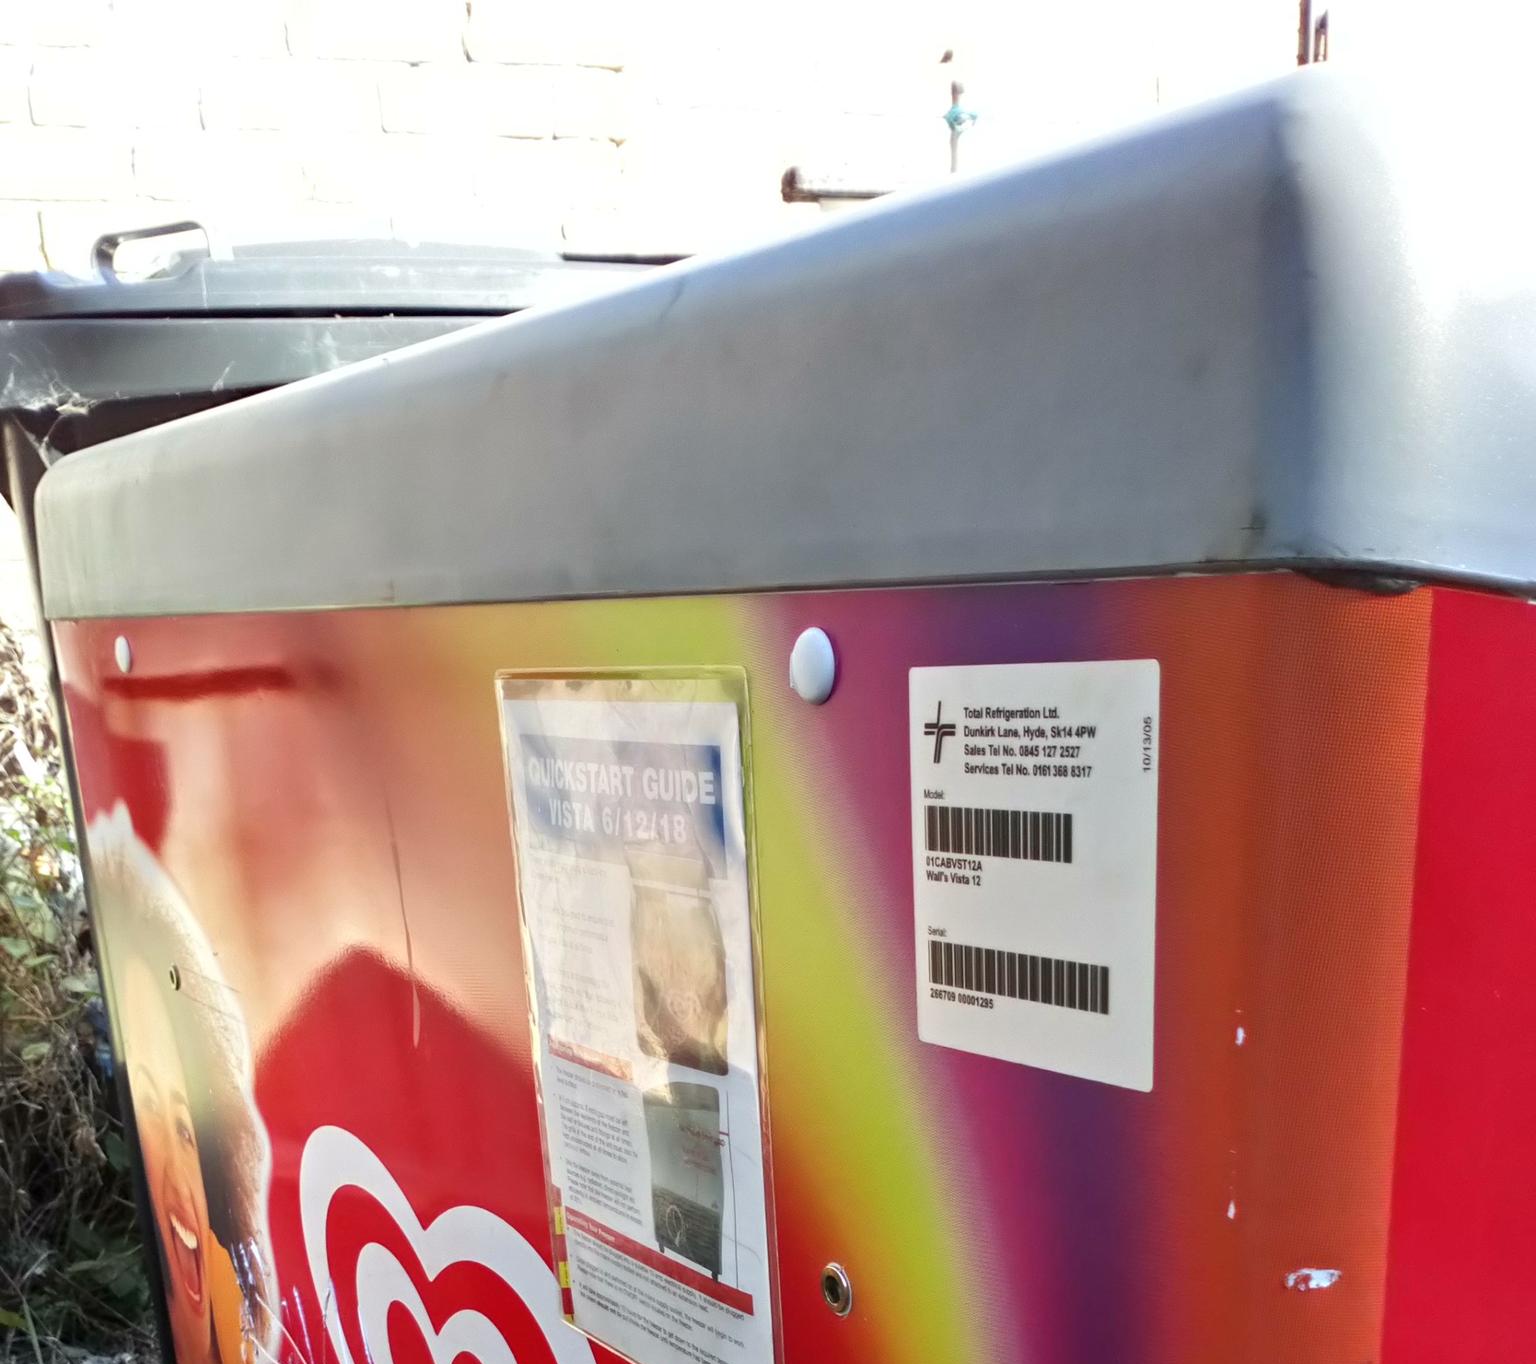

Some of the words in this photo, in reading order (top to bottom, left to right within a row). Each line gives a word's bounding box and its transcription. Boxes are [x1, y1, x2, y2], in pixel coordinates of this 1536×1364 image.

[963, 706, 983, 719] Total
[985, 706, 1041, 721] Refrigeration
[1042, 706, 1060, 719] Ltd.
[963, 725, 996, 738] Dunkirk
[997, 726, 1021, 739] Lane,
[1022, 726, 1048, 741] Hyde,
[1050, 726, 1073, 739] Sk14
[1074, 726, 1097, 739] 4PW
[963, 743, 986, 756] Sales
[988, 744, 1001, 757] Tel
[1002, 744, 1017, 757] No.
[1019, 745, 1040, 757] 0845
[1042, 745, 1057, 758] 127
[1059, 745, 1081, 758] 2527
[963, 761, 999, 775] Services
[1001, 762, 1014, 776] Tel
[1016, 763, 1030, 776] No.
[1032, 764, 1051, 777] 0161
[528, 757, 635, 798] QUICKSTART
[642, 767, 716, 806] GUIDE
[549, 798, 596, 833] VISTA
[602, 806, 688, 844] 6/12/18
[926, 870, 949, 883] Wall's
[950, 872, 970, 885] Vista
[972, 874, 982, 887] 12
